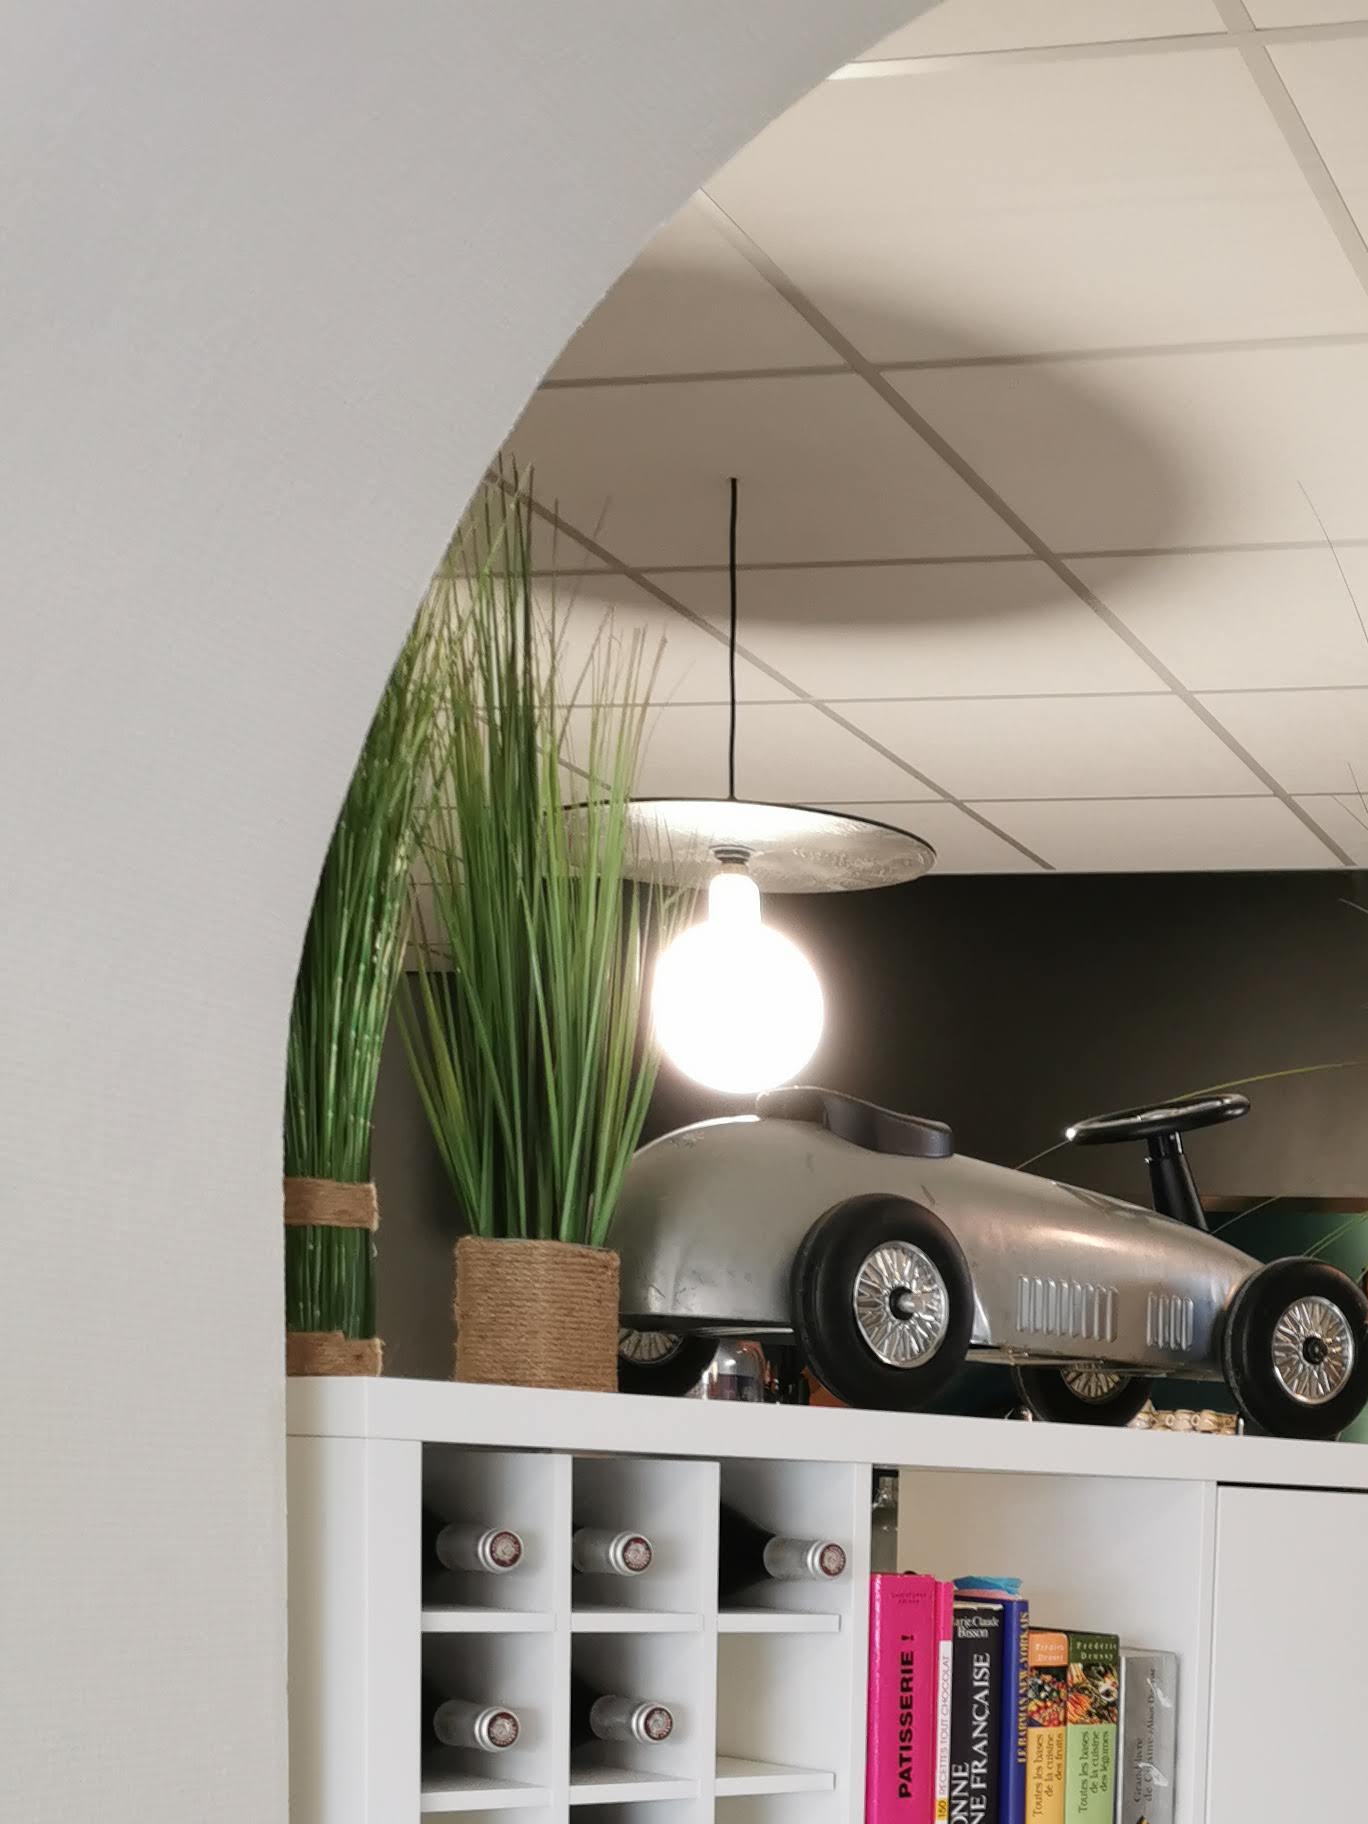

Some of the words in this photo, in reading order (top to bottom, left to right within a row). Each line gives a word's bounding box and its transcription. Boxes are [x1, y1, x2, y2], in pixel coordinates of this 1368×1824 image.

[942, 1656, 950, 1714] CHOCOLAT
[899, 1651, 914, 1798] PATISSERIE
[971, 1652, 990, 1789] FRANÇAISE
[1033, 1734, 1043, 1763] bases
[1046, 1734, 1054, 1770] cuisine
[1055, 1733, 1063, 1760] fruits
[1079, 1732, 1089, 1760] bases
[1091, 1731, 1099, 1767] cuisine
[1100, 1731, 1110, 1771] légumes
[938, 1748, 948, 1795] RECETTES
[1034, 1766, 1043, 1780] les
[1045, 1771, 1053, 1782] la
[1055, 1763, 1063, 1781] des
[1079, 1762, 1088, 1776] les
[1090, 1770, 1099, 1779] la
[1033, 1782, 1043, 1817] Toutes
[1044, 1784, 1053, 1797] de
[1078, 1779, 1088, 1813] Toutes
[1089, 1781, 1098, 1793] de
[937, 1801, 947, 1817] 150
